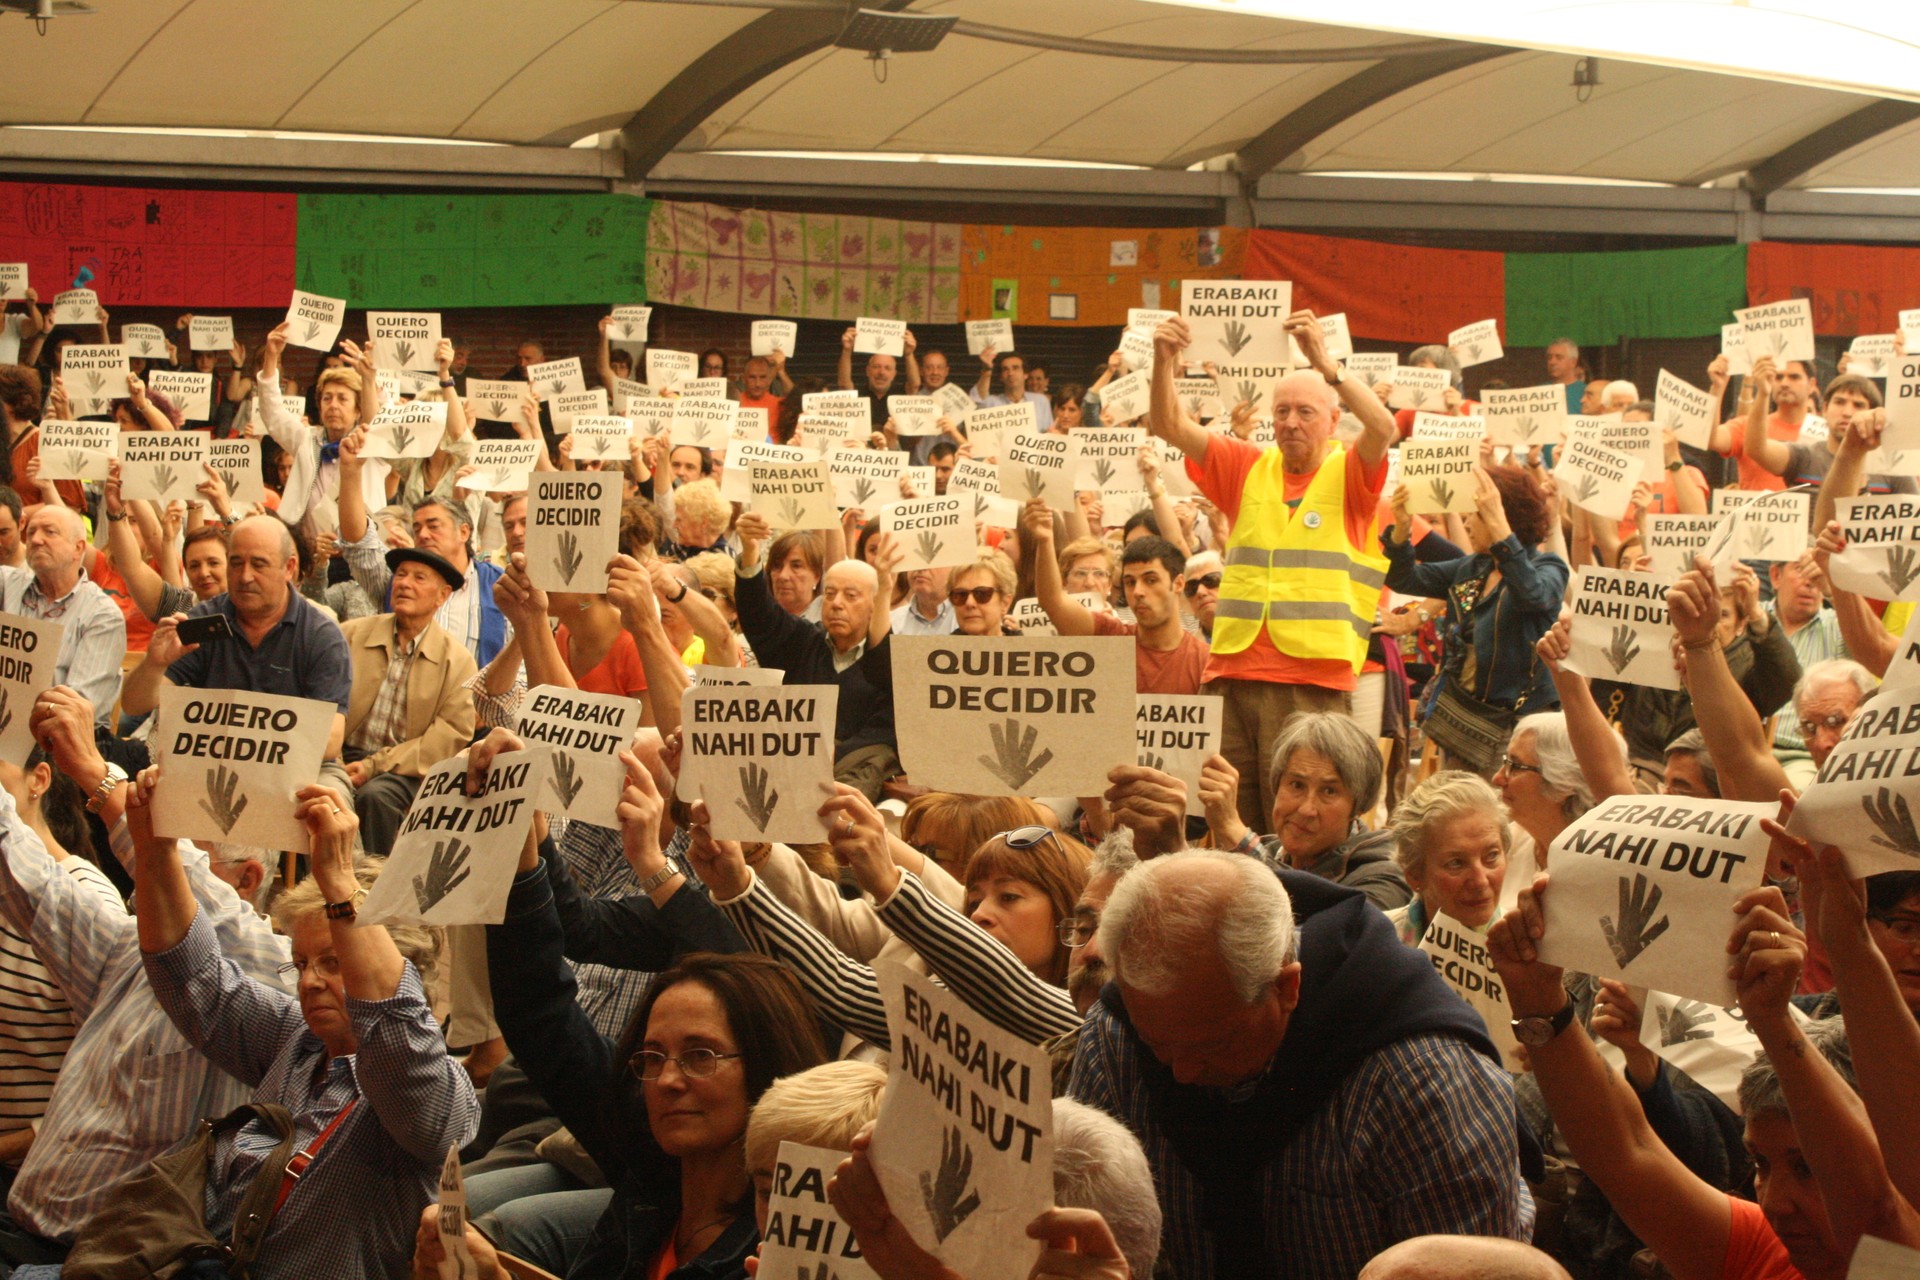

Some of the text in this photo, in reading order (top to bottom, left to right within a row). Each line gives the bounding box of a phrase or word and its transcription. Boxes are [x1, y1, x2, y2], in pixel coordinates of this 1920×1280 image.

[1193, 287, 1277, 300] ERABAKI
[300, 297, 335, 311] QUIERO
[1189, 304, 1281, 317] NAHI DUT
[297, 308, 334, 323] DECIDIR
[1744, 306, 1802, 320] ERABAKI
[376, 317, 428, 327] QUIERO
[1744, 317, 1806, 332] NAHI DUT
[376, 329, 429, 339] DECIDIR
[66, 349, 121, 358] ERABAKI
[64, 360, 124, 369] NAHI DUT
[1218, 366, 1286, 376] AHI DUT
[155, 374, 205, 384] ERABAKI
[152, 384, 207, 393] NAHI DUT
[1662, 377, 1708, 407] ERABAKI
[558, 394, 597, 404] QUIERO
[633, 400, 674, 408] ERABAK
[1489, 391, 1555, 403] ERABAKI
[1659, 389, 1708, 419] NAHI DUT
[376, 404, 433, 415] QUIERO
[559, 403, 598, 413] DECIDIR
[681, 400, 731, 411] ERABAKI
[1487, 404, 1526, 415] NAHI
[1529, 403, 1559, 413] DUT
[372, 414, 431, 424] DECIDIR
[578, 418, 626, 427] ERABAKI
[676, 409, 733, 421] NAHI DUT
[971, 407, 1027, 423] ERABAKI
[46, 425, 110, 436] ERABAKI
[971, 417, 1030, 433] NAHI DUT
[1423, 419, 1482, 428] ERABAKI
[1074, 433, 1135, 443] RABAKI
[1418, 429, 1454, 438] NAHI
[1602, 427, 1649, 437] QUIERO
[42, 437, 112, 448] NAHI DUT
[128, 436, 200, 447] ERABAKI
[479, 443, 535, 453] ERABAKI
[125, 451, 203, 462] NAHI DUT
[742, 446, 804, 462] QUIERO
[1010, 449, 1064, 468] DECIDIR
[1080, 446, 1136, 457] AHI DUT
[1407, 446, 1470, 460] ERABAKI
[1573, 442, 1628, 469] QUIERO
[474, 454, 535, 465] NAHI DUT
[835, 453, 899, 466] ERABAKI
[753, 468, 818, 479] ERABAKI
[830, 464, 900, 478] NAHI DUT
[959, 463, 998, 480] ERABA
[1404, 461, 1474, 476] NAHI DUT
[1568, 455, 1624, 483] DECIDIR
[539, 483, 602, 500] QUIERO
[752, 482, 825, 494] NAHI DUT
[952, 476, 1000, 494] NAHI DU
[894, 500, 959, 517] QUIERO
[1850, 503, 1920, 521] ERAB
[536, 508, 601, 526] DECIDIR
[893, 514, 959, 531] DECIDIR
[1768, 513, 1801, 524] DUT
[1654, 522, 1717, 533] ERABAK
[1845, 526, 1904, 544] NAHI
[1651, 535, 1693, 548] NAHI
[1583, 575, 1670, 601] ERABAK
[1575, 598, 1671, 625] NAHI DUT
[0, 624, 38, 653] ERO
[927, 649, 1095, 678] QUIERO
[929, 684, 1096, 714] DECIDIR
[183, 700, 297, 733] QUIERO
[531, 694, 625, 728] ERABAKI
[694, 699, 815, 722] ERABAKI
[1137, 704, 1205, 724] ABAKI
[517, 718, 623, 756] NAHI DUT
[1161, 731, 1210, 750] DUT
[172, 732, 290, 765] DECIDIR
[692, 733, 820, 757] NAHI DUT
[1816, 750, 1902, 785] NAHI
[402, 798, 525, 836] NAHI DUT
[1597, 803, 1755, 839] ERABAKI
[1564, 829, 1746, 883] NAHI DUT
[1426, 925, 1496, 974] QUIERO
[1431, 957, 1502, 1001] ECIDIR
[903, 986, 1031, 1105] ERABAKI
[899, 1033, 1042, 1164] NAHI DUT
[765, 1212, 837, 1254] AHI
